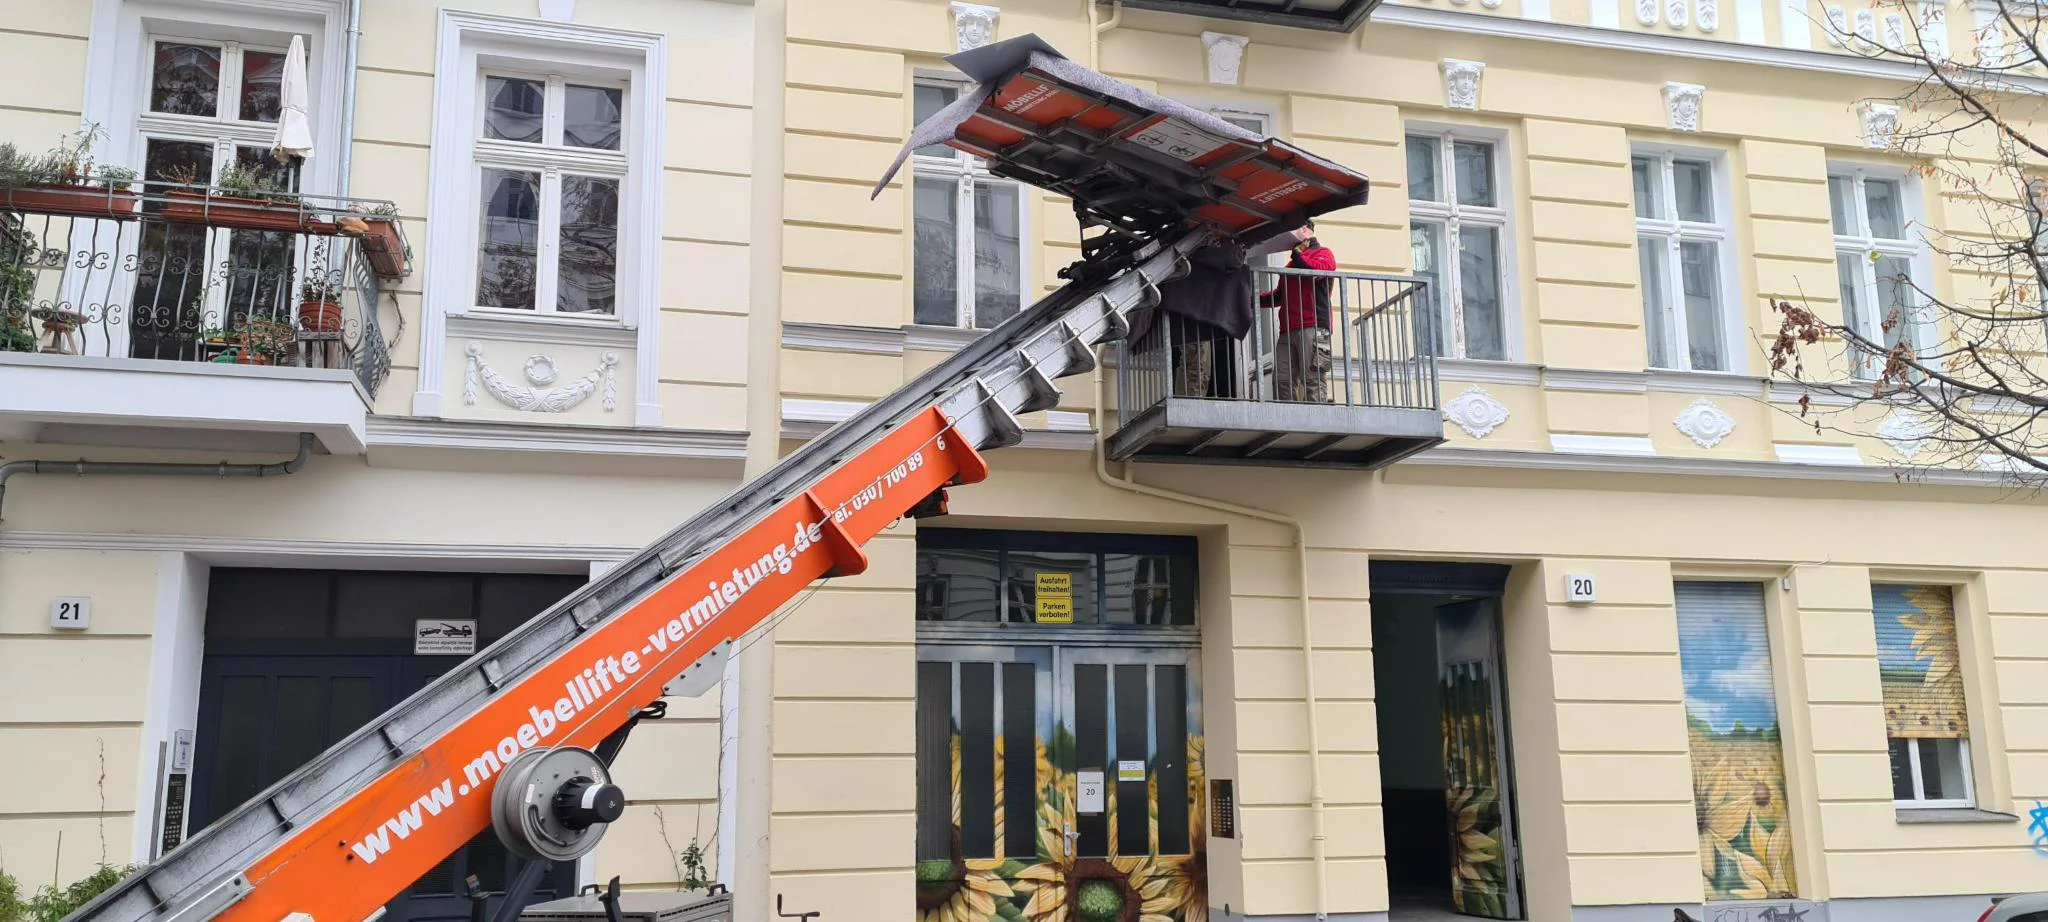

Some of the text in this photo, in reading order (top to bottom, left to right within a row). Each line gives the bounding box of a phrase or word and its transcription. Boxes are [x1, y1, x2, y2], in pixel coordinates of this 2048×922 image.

[831, 502, 853, 523] el.
[884, 464, 908, 489] 700
[907, 452, 924, 472] 89
[936, 435, 946, 451] 6
[1574, 579, 1593, 596] 20
[59, 602, 80, 620] 21
[1043, 602, 1066, 610] Parken
[1086, 788, 1096, 796] 20
